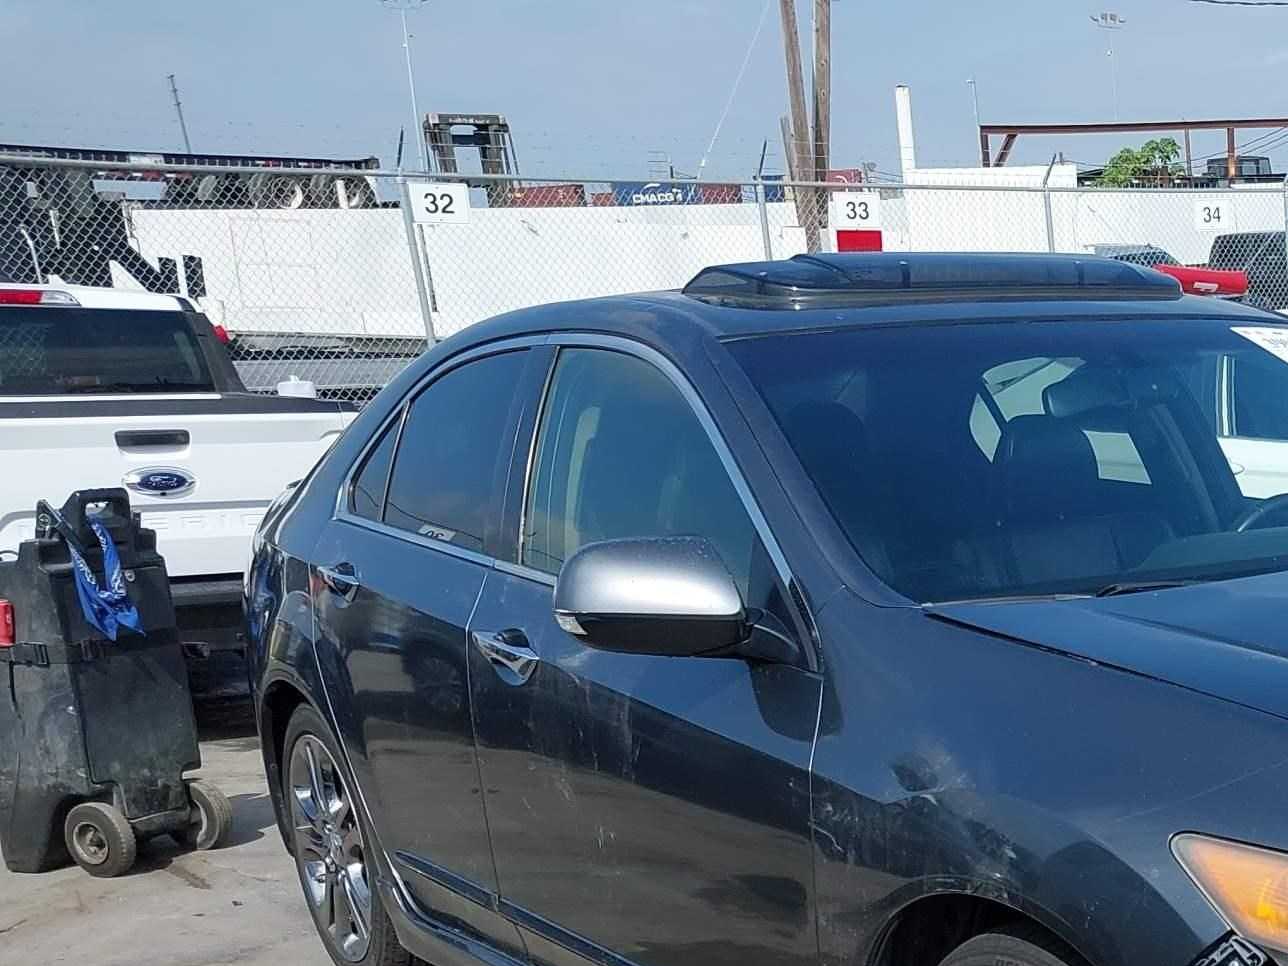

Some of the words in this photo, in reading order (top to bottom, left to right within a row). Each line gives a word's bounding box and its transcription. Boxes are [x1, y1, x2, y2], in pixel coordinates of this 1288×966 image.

[423, 192, 455, 214] 32
[846, 201, 869, 220] 33
[1203, 206, 1221, 223] 34
